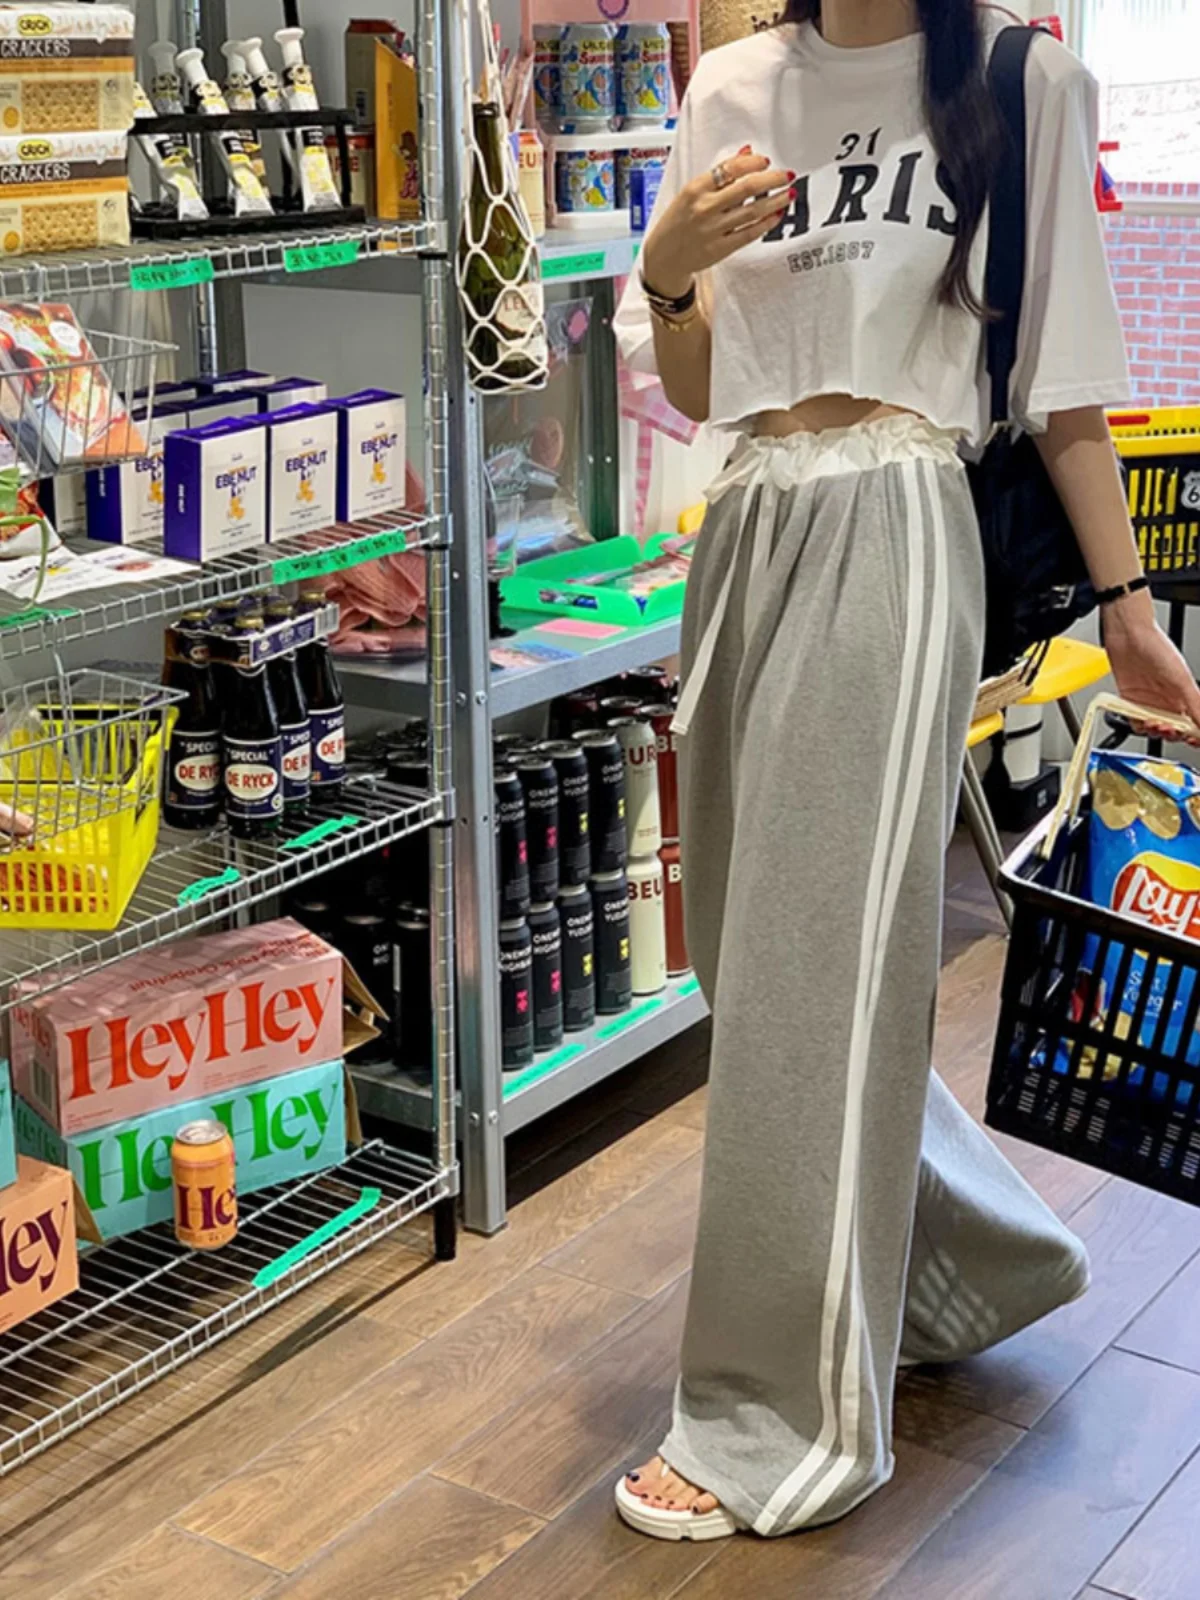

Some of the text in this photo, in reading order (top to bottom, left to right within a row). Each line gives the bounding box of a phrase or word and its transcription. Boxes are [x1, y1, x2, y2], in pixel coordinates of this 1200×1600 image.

[0, 38, 71, 57] CRACKERS
[834, 127, 882, 161] 31
[0, 162, 71, 184] CRACKERS
[753, 151, 958, 243] ARIS
[242, 772, 275, 788] RYCK
[1119, 865, 1200, 933] Lay
[66, 976, 335, 1100] HeyHey
[76, 1083, 339, 1212] HeHey
[177, 1184, 238, 1231] He
